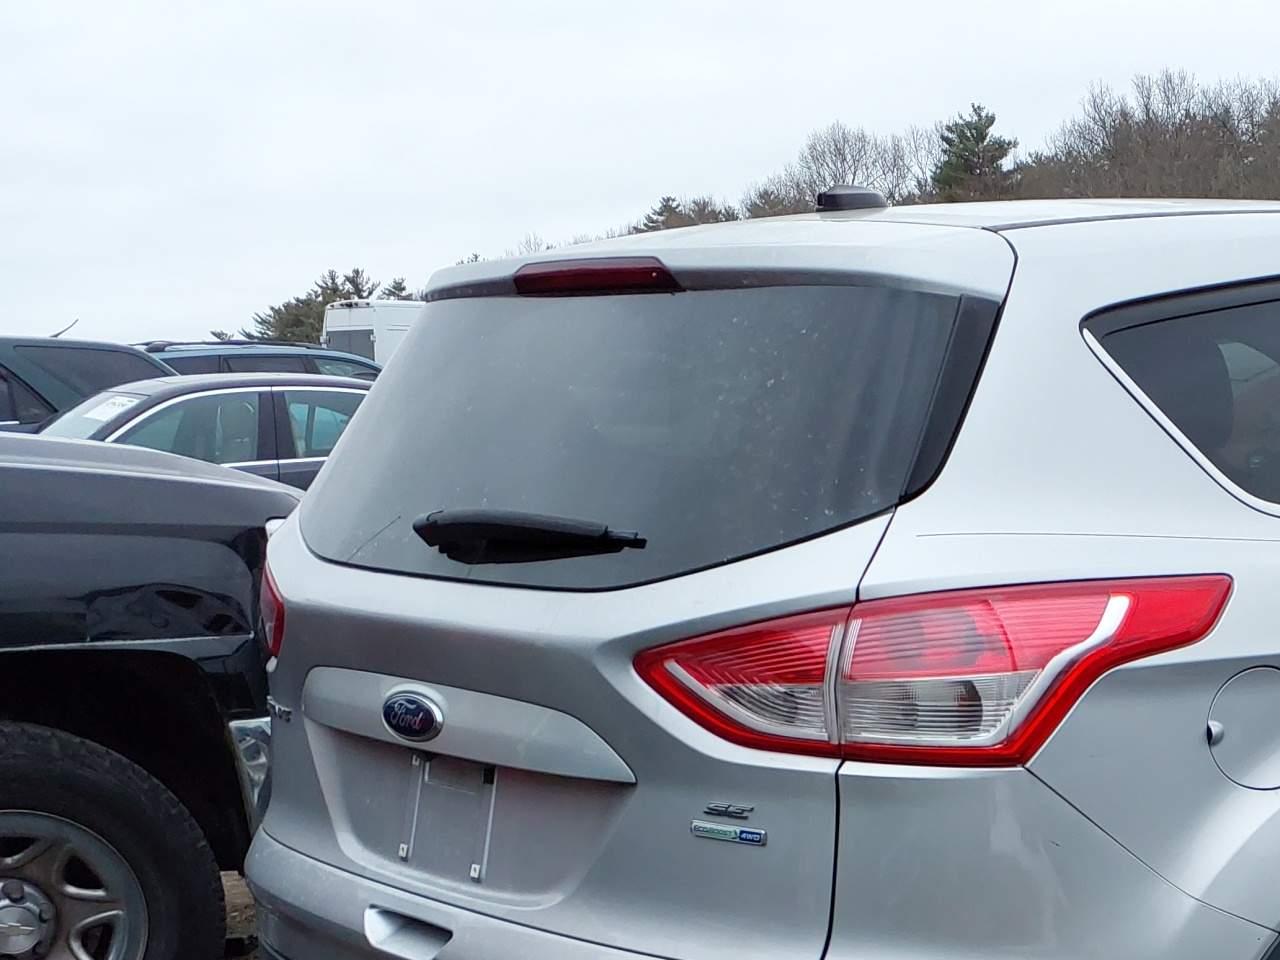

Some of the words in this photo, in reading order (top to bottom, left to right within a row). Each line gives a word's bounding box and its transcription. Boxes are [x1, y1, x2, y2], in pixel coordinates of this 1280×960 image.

[390, 699, 424, 730] Ford
[703, 800, 755, 820] SE
[740, 832, 761, 842] 4WD
